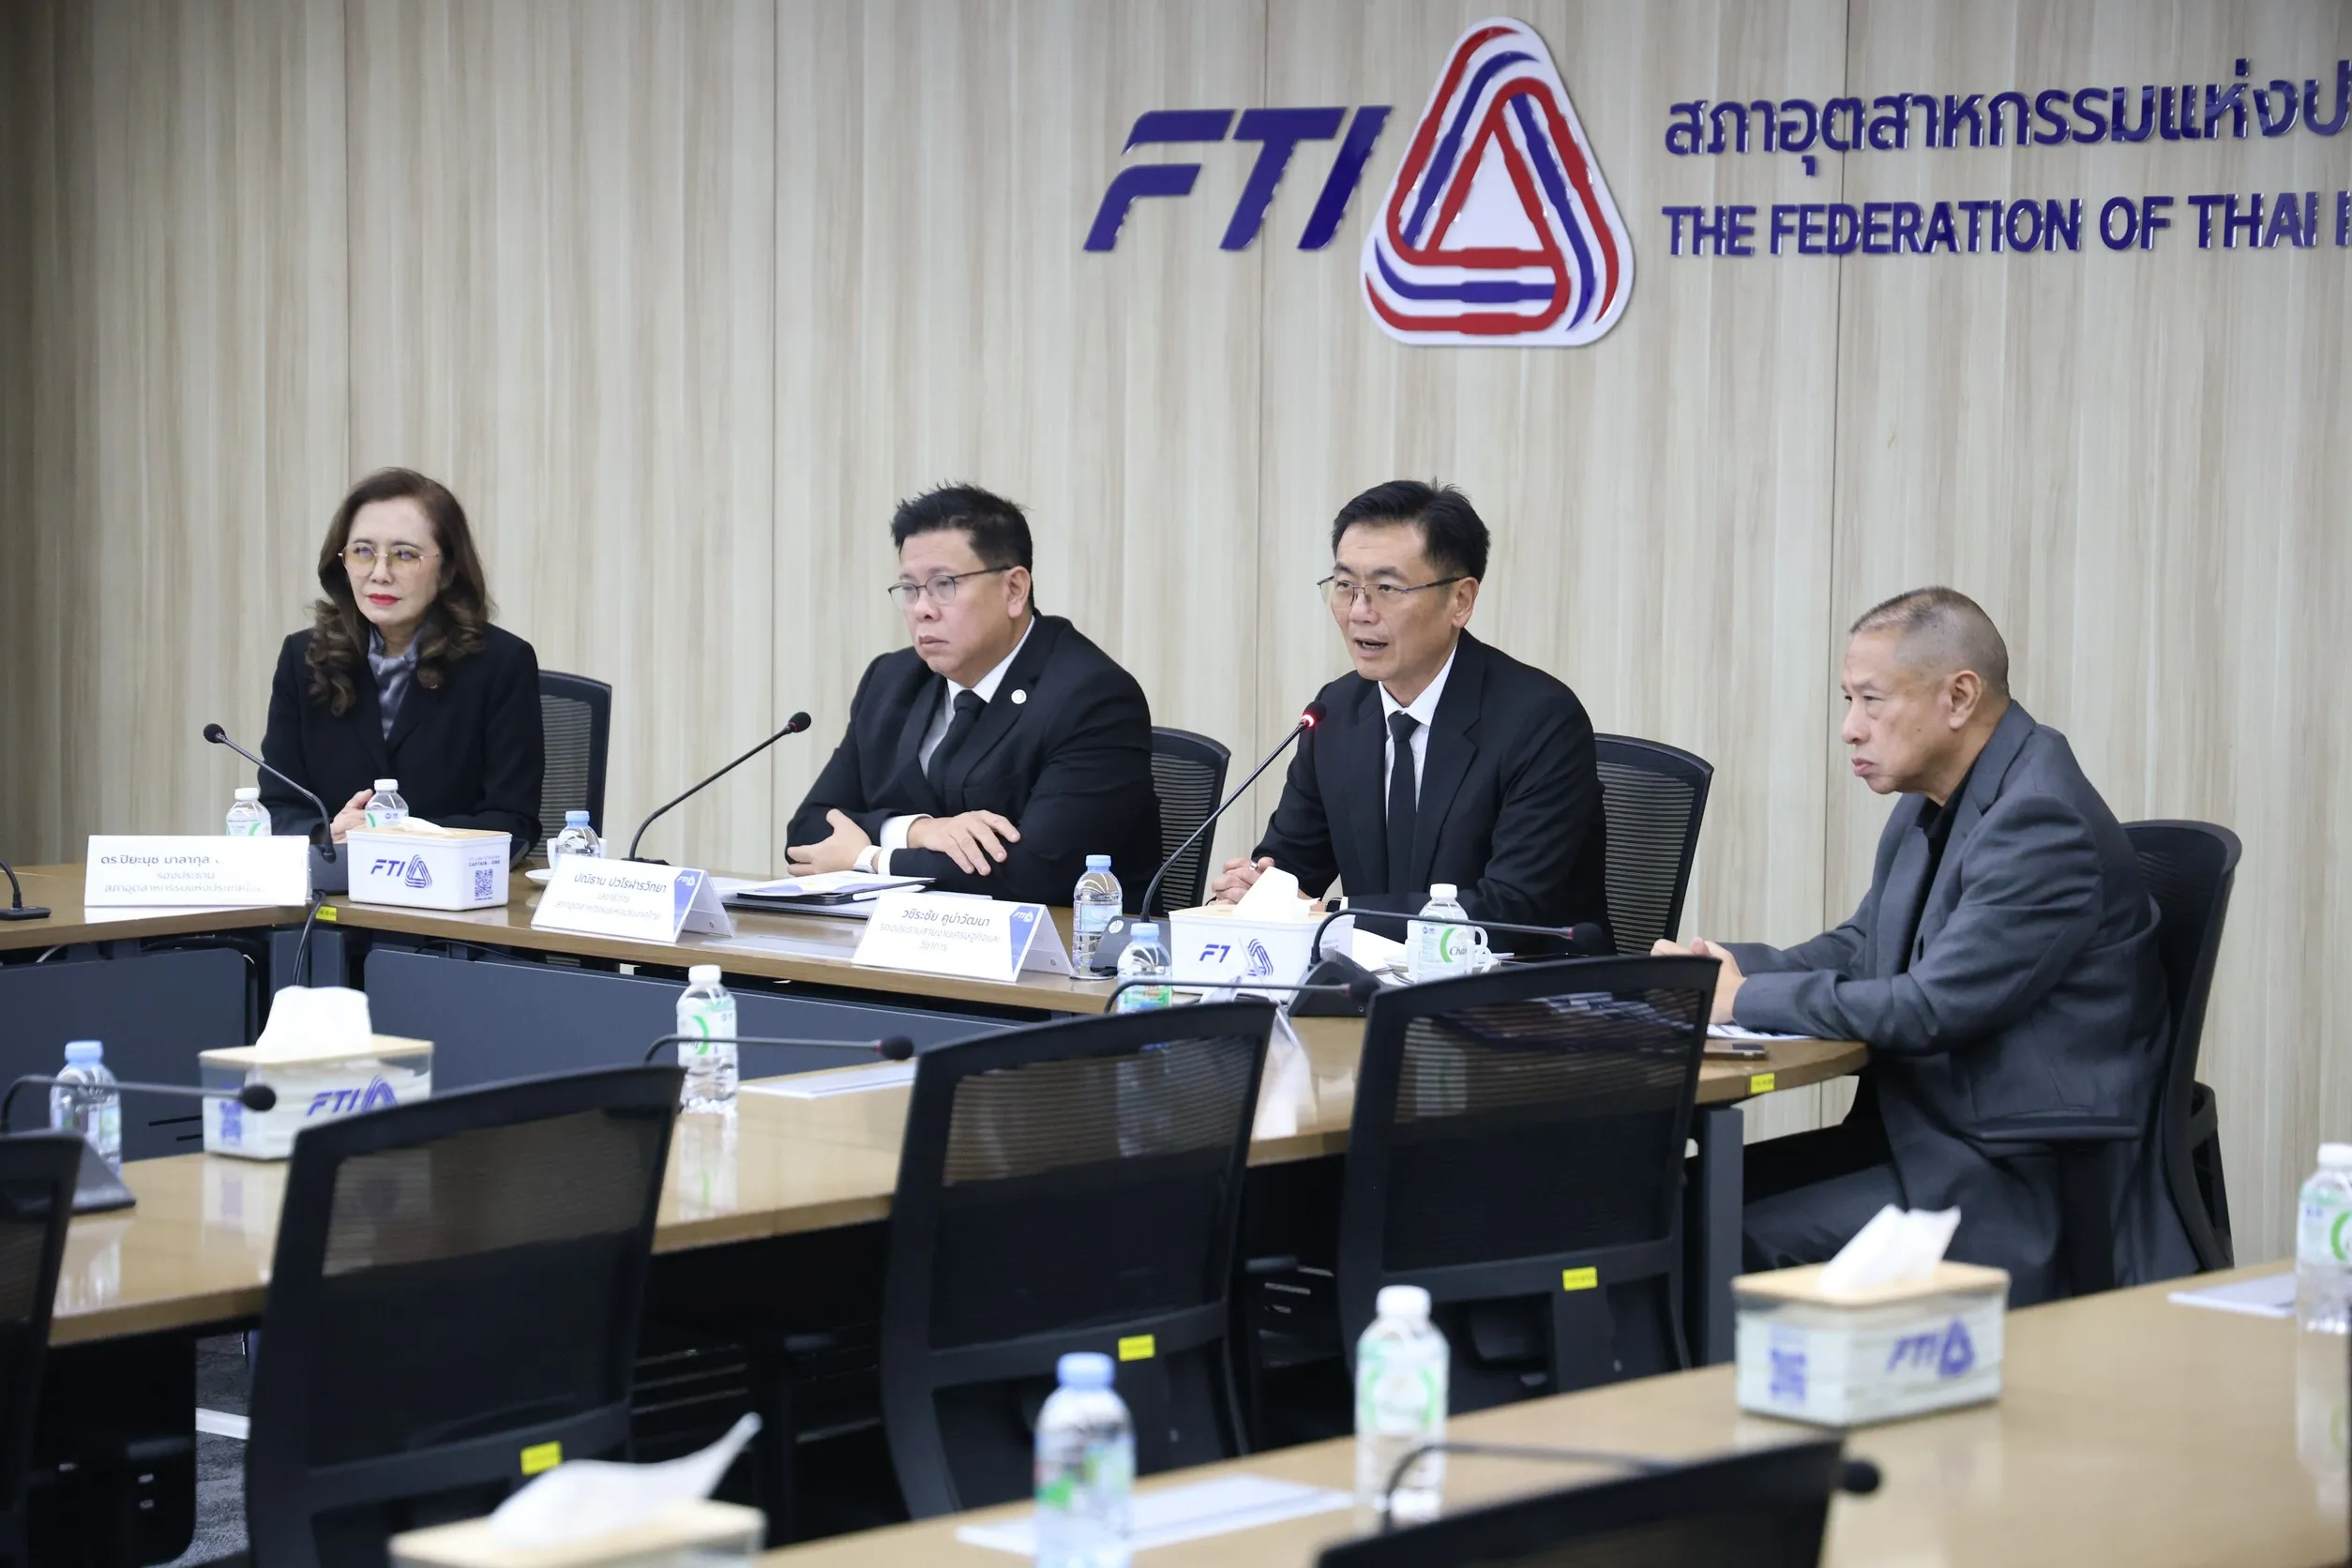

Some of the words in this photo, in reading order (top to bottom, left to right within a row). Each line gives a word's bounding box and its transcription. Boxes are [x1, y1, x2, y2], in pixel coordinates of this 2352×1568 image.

[1665, 59, 2352, 177] สภาอุตสาหกรรมแห่งป
[1084, 106, 1393, 251] FTI
[1661, 204, 1756, 256] THE
[1770, 199, 2081, 255] FEDERATION
[2100, 195, 2174, 250] OF
[2188, 191, 2317, 249] THAI
[370, 858, 405, 878] FTI
[307, 1089, 360, 1116] FTI
